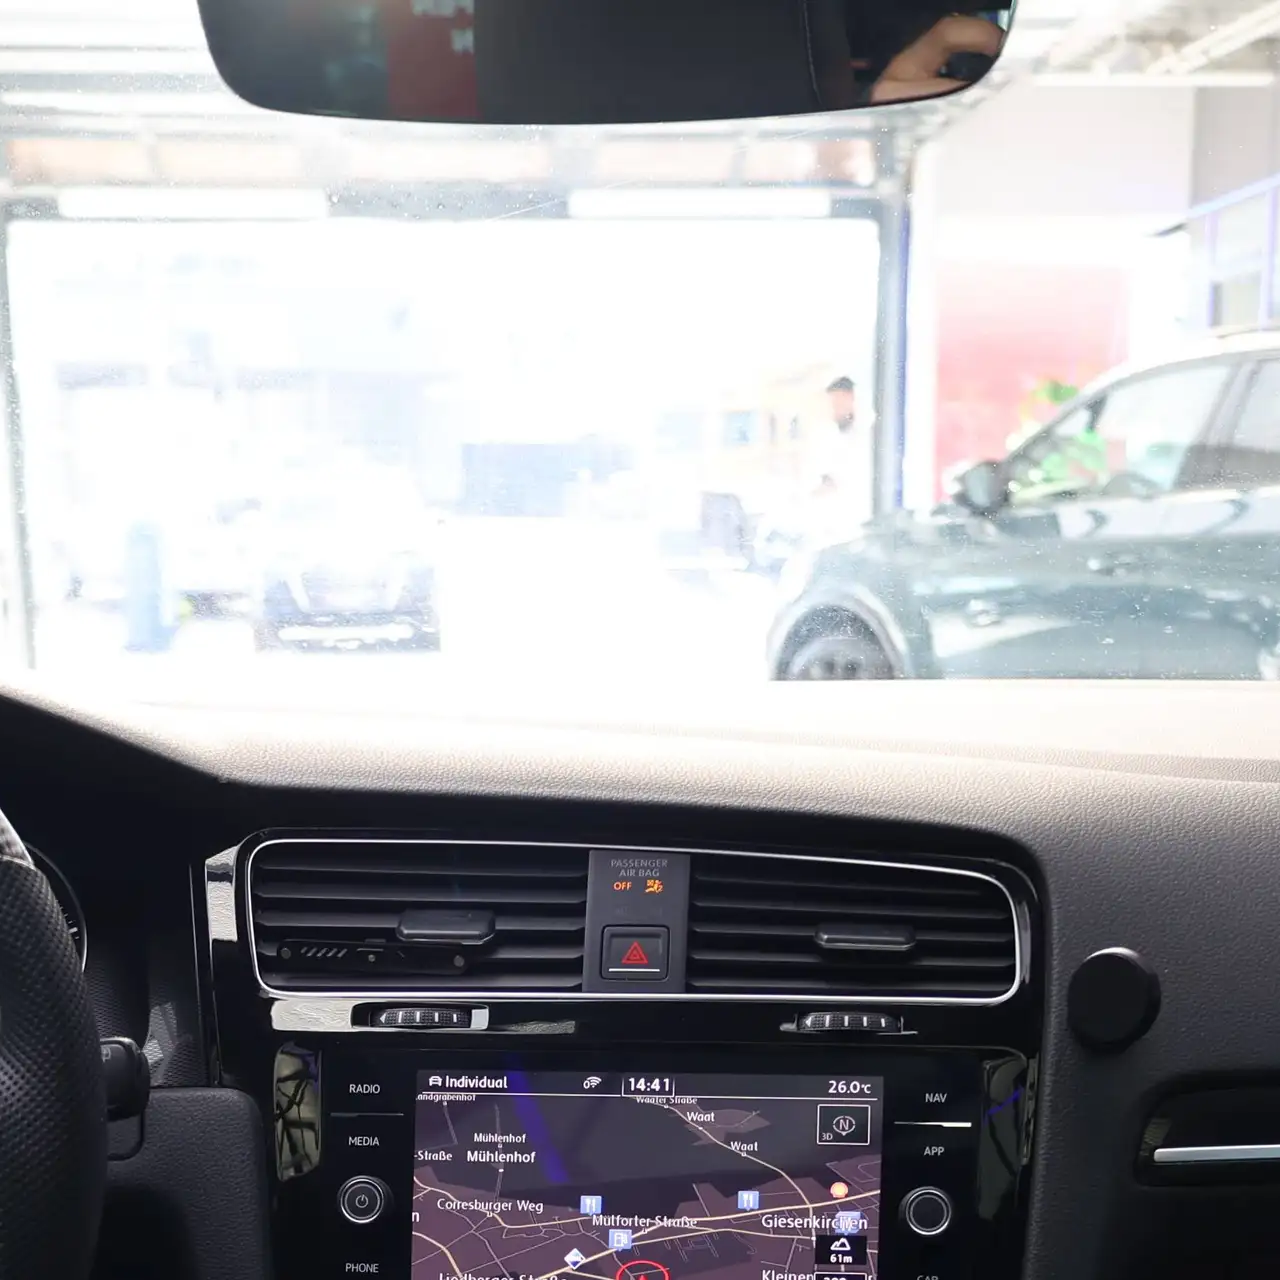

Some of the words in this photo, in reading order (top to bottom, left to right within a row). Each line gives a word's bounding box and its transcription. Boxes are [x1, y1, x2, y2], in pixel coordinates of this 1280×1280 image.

[610, 859, 669, 868] PASSENGER
[618, 868, 636, 877] AIR
[638, 868, 660, 877] BAG
[613, 881, 632, 891] OFF
[444, 1075, 508, 1089] Individual
[628, 1077, 671, 1092] 14:41
[348, 1083, 381, 1095] RADIO
[925, 1092, 947, 1103] NAV
[686, 1111, 716, 1122] Waat
[348, 1136, 380, 1147] MEDIA
[473, 1132, 527, 1143] Mühlenhof
[821, 1132, 833, 1141] 3D
[730, 1141, 759, 1152] Waat
[924, 1146, 945, 1157] APP
[466, 1150, 537, 1163] Mühlenhof
[436, 1198, 513, 1212] Corresburger
[516, 1199, 545, 1214] Weg
[654, 1215, 698, 1229] Straße
[345, 1262, 380, 1274] PHONE
